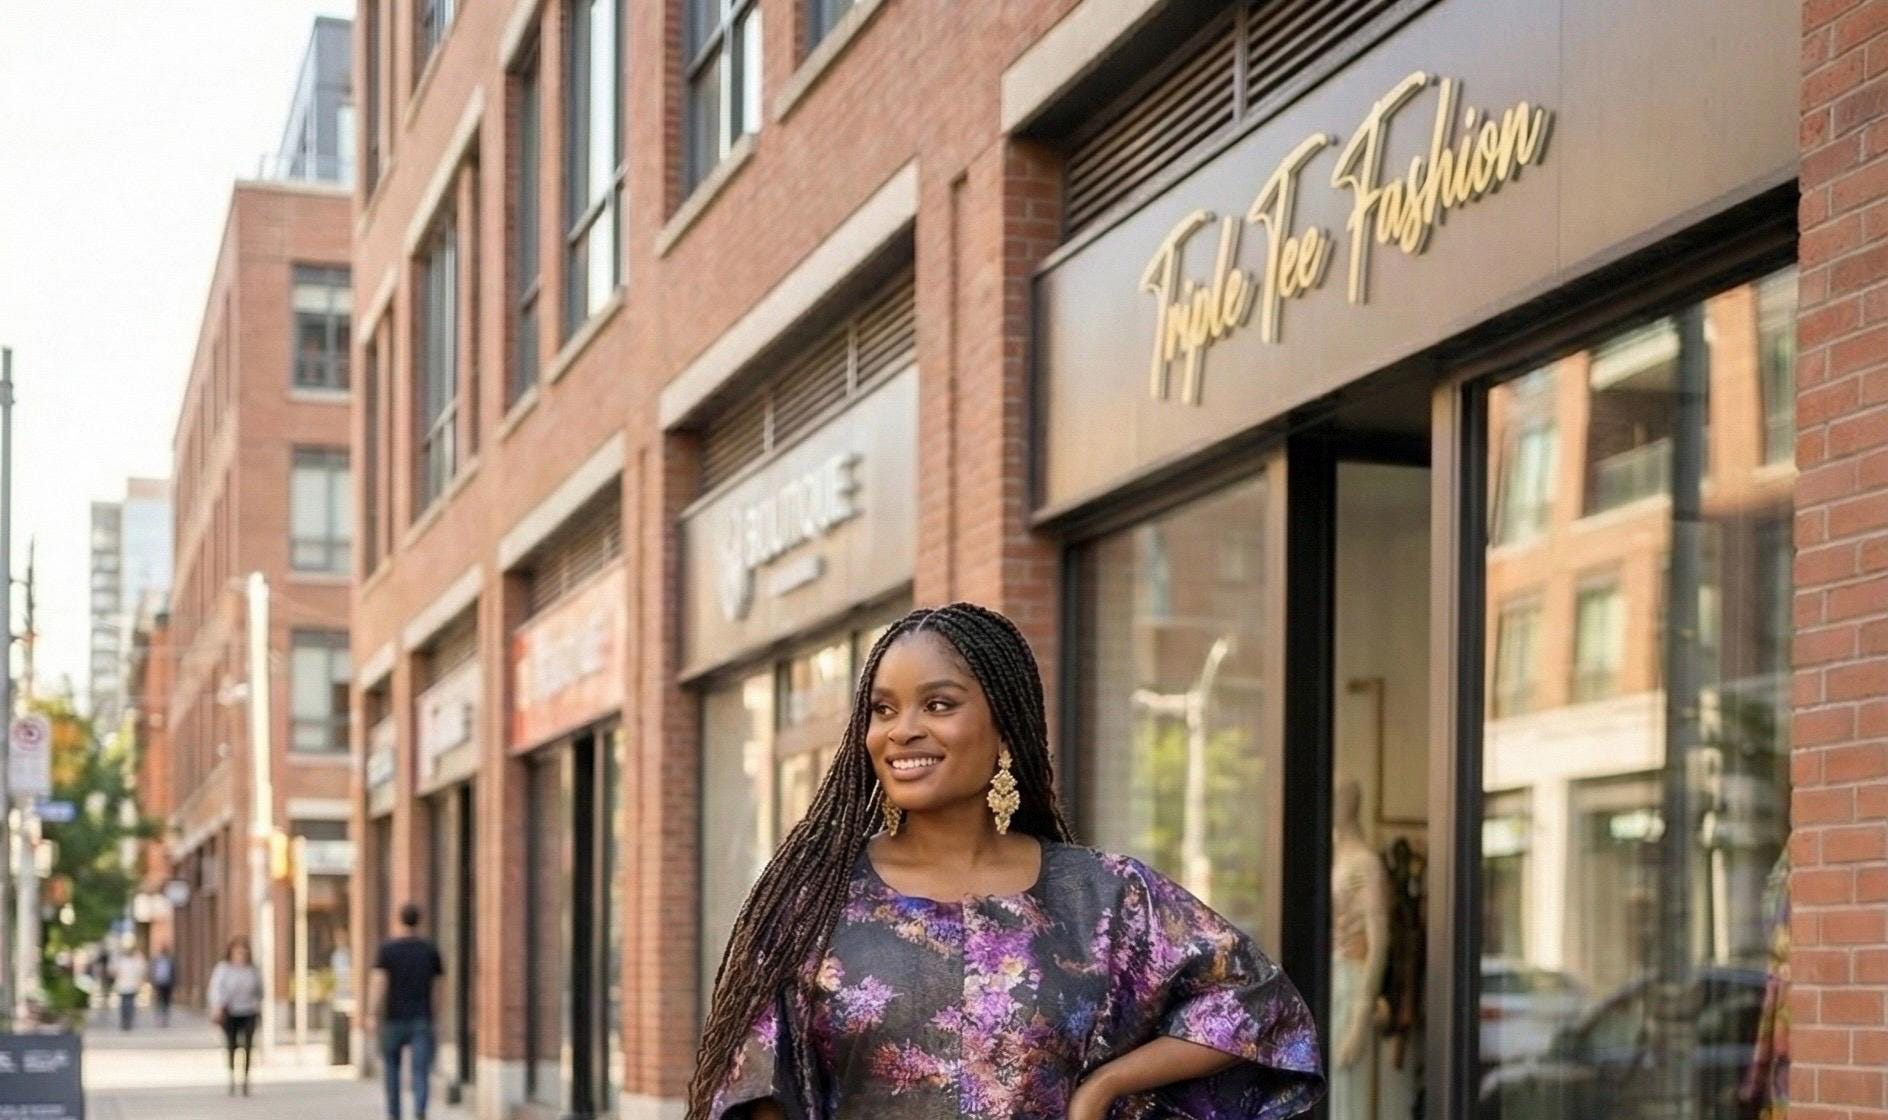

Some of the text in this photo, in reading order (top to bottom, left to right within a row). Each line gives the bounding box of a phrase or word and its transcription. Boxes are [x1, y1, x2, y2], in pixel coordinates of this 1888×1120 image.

[1140, 70, 1554, 405] Triple Tee Fashion
